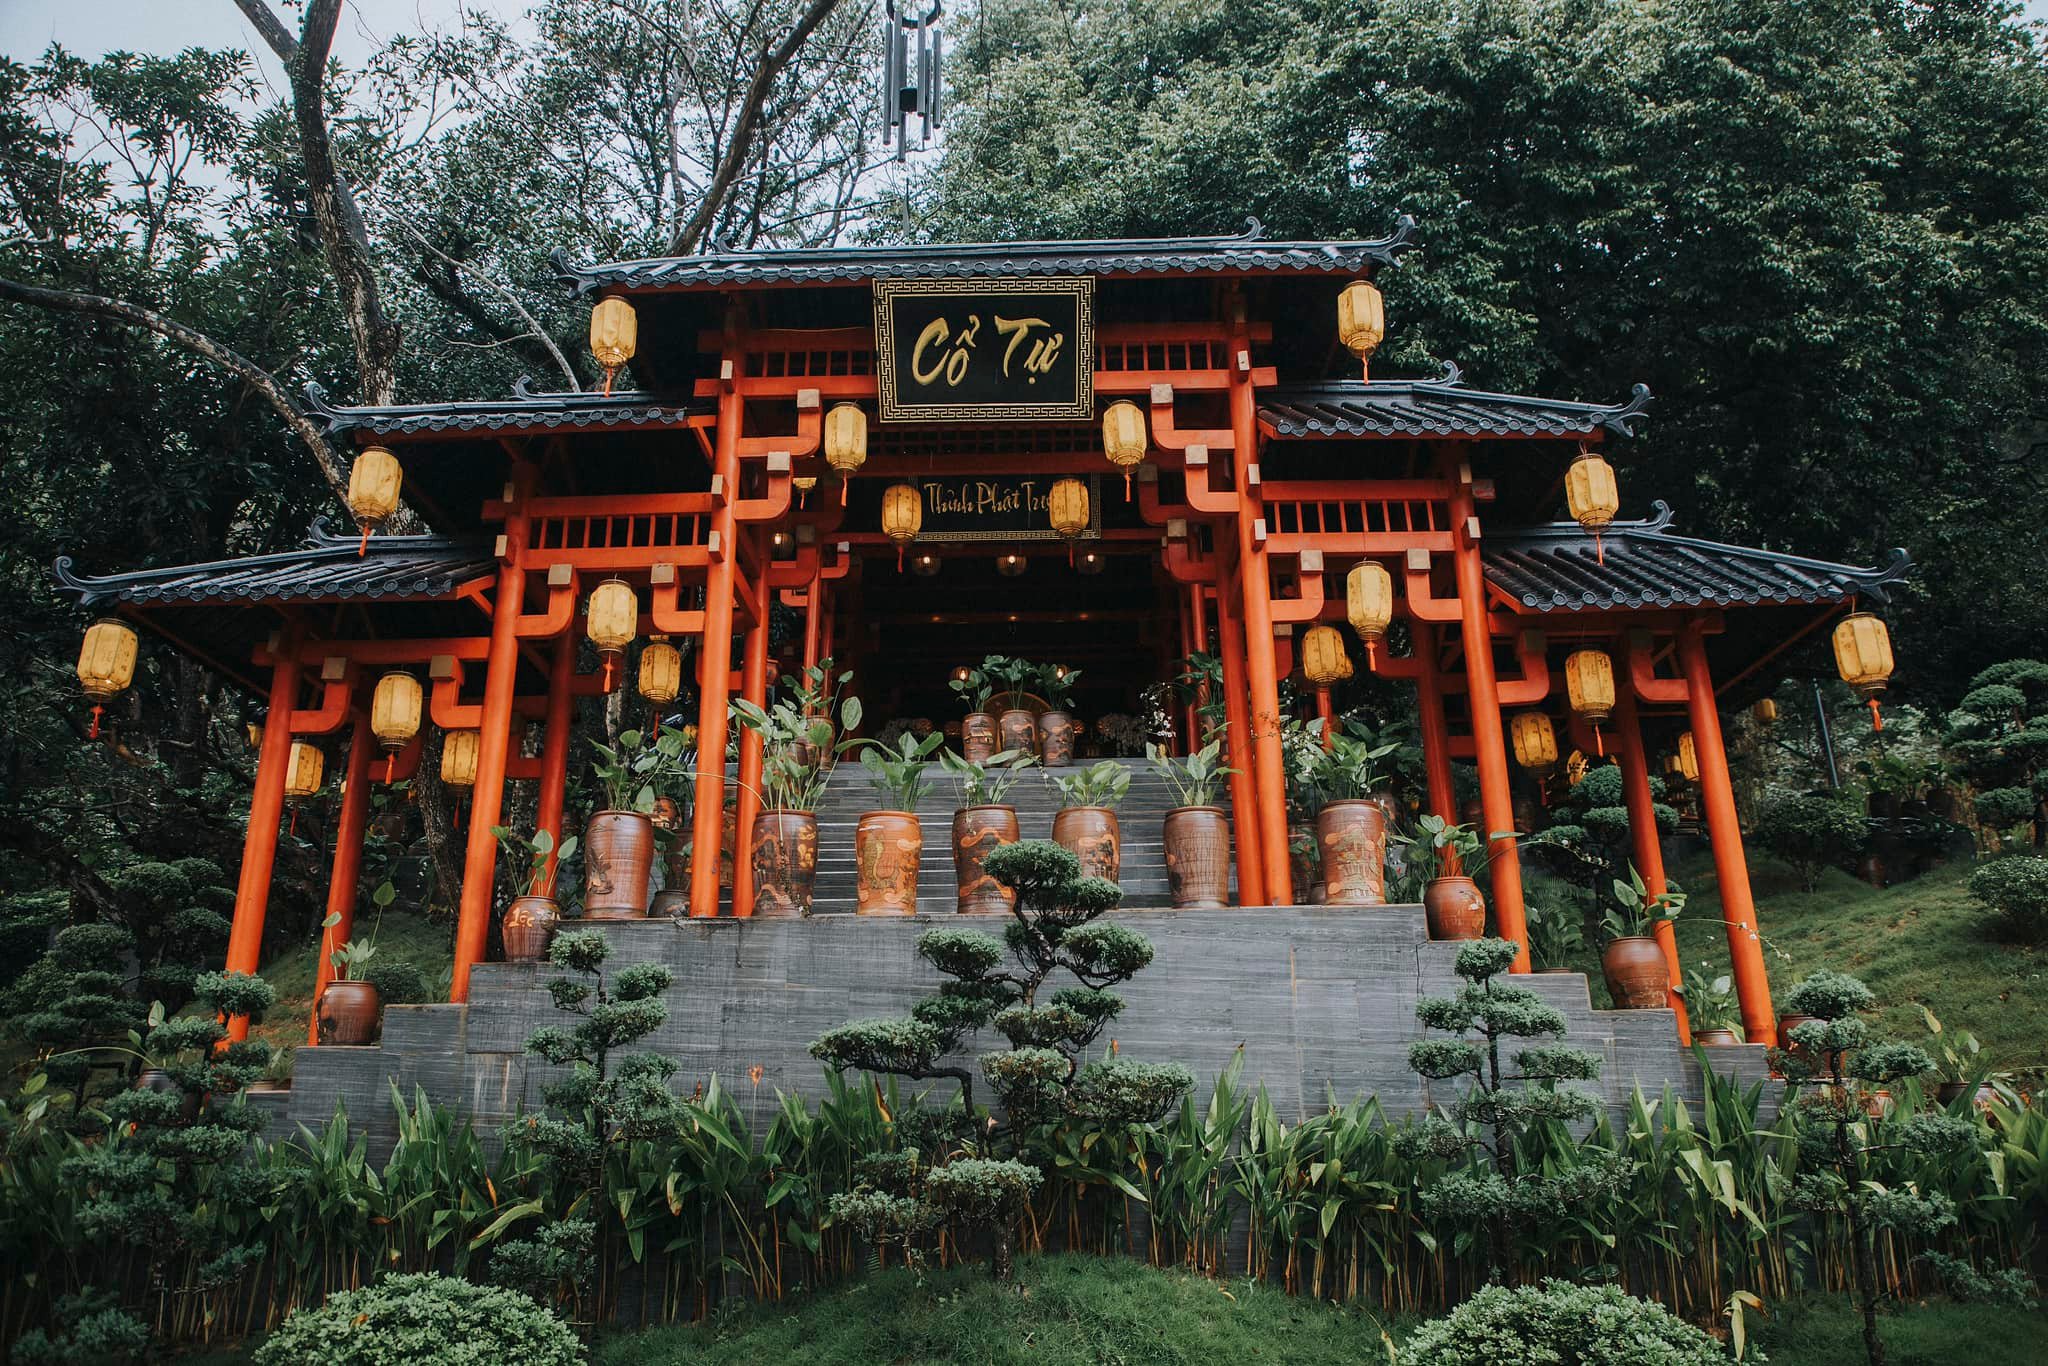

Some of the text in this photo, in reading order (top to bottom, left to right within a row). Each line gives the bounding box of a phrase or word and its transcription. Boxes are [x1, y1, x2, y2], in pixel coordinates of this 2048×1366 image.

[912, 314, 1064, 387] Cổ Tự
[976, 481, 1020, 514] Phật
